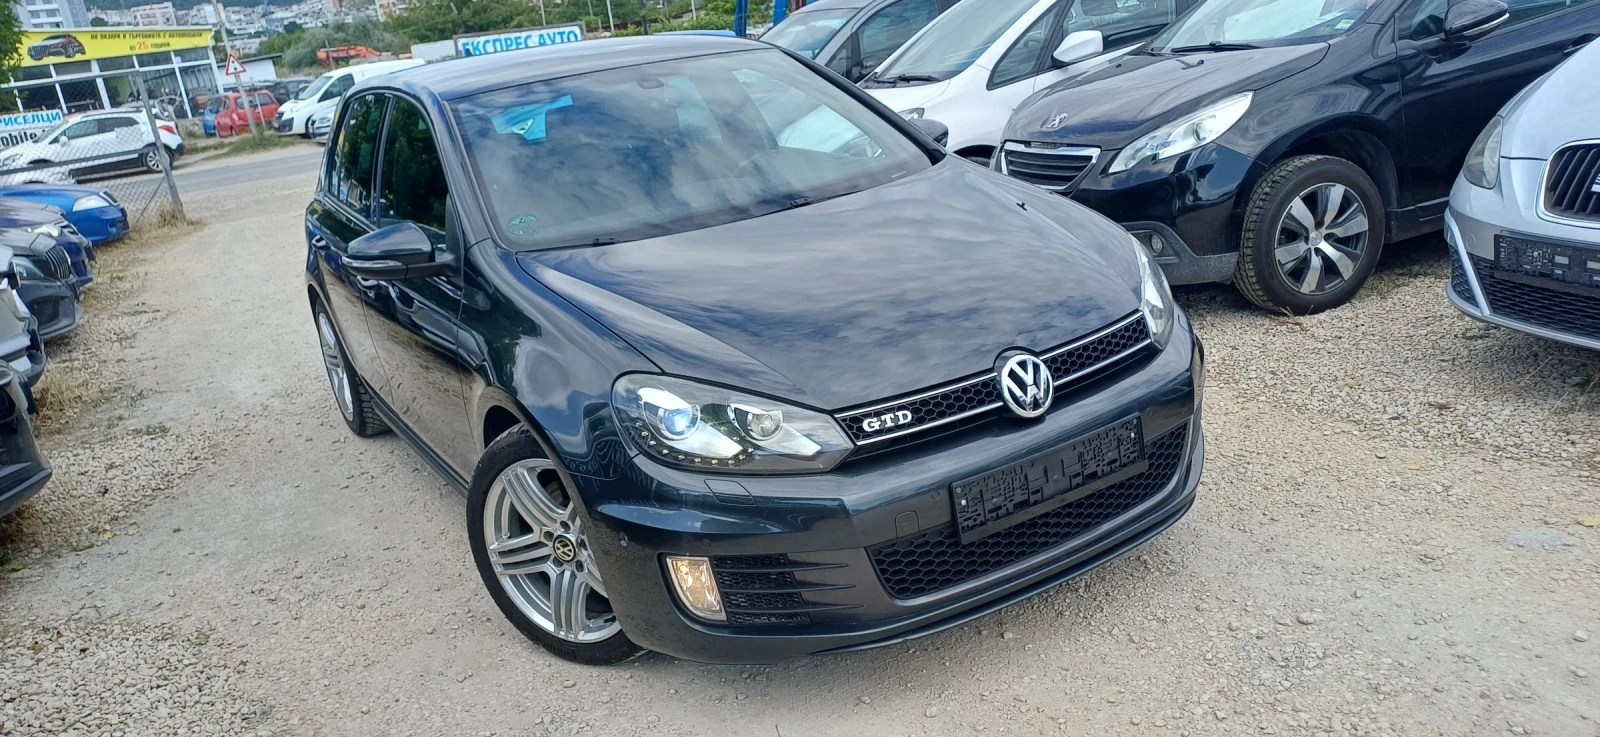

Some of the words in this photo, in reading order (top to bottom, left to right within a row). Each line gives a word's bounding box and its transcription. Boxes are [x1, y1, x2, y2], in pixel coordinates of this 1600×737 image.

[137, 41, 149, 50] 25
[462, 35, 532, 56] ЕКСПРЕС
[862, 410, 912, 432] GTD
